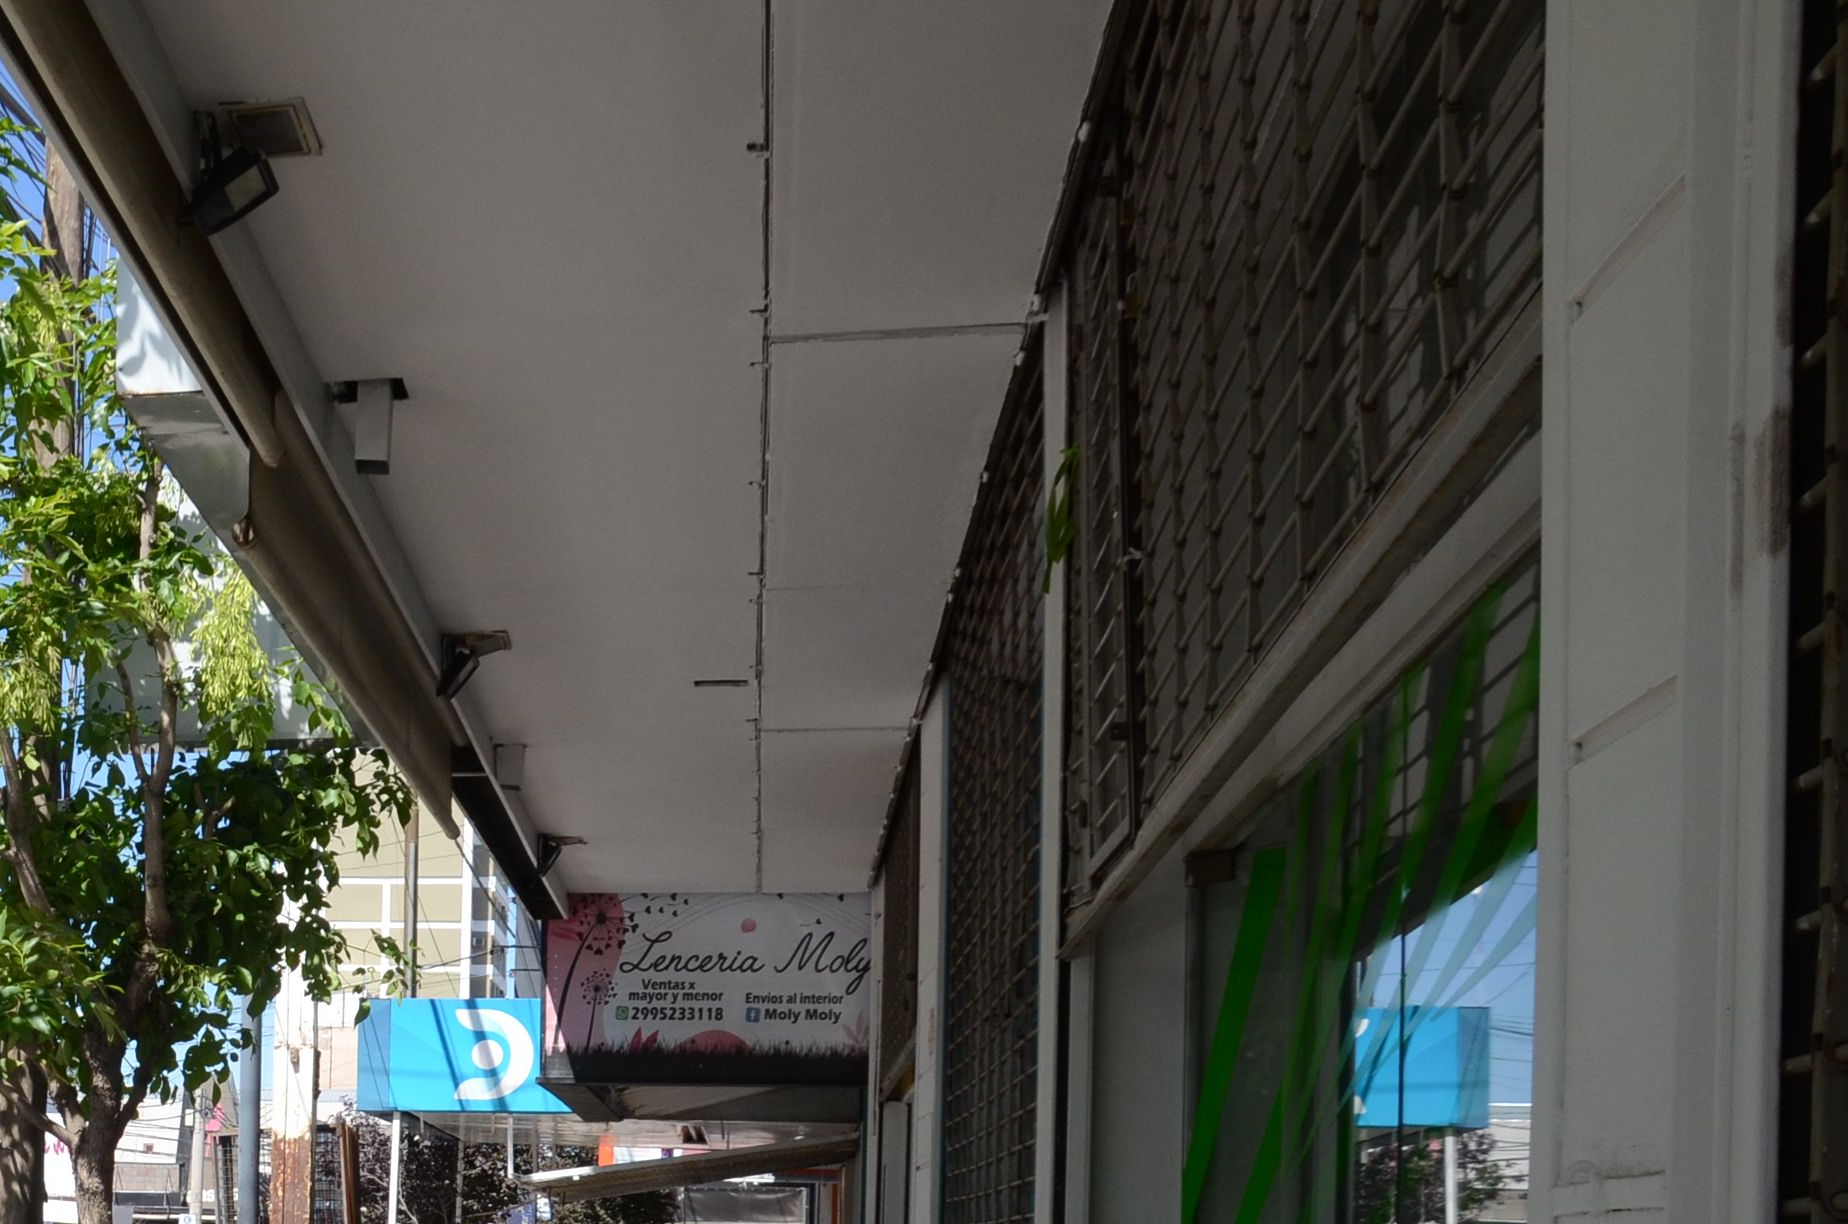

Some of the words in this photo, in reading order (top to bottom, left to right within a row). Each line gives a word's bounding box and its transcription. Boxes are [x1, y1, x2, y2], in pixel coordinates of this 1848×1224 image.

[619, 930, 766, 974] Lenceria
[773, 930, 871, 996] Moly
[641, 978, 685, 991] Ventas
[687, 981, 696, 991] x
[628, 991, 670, 1004] mayor
[671, 992, 680, 1005] y
[682, 992, 724, 1002] menor
[786, 992, 797, 1005] al
[799, 992, 844, 1005] interior
[630, 1006, 724, 1022] 2995233118
[763, 1007, 800, 1024] Moly
[804, 1007, 842, 1024] Moly
